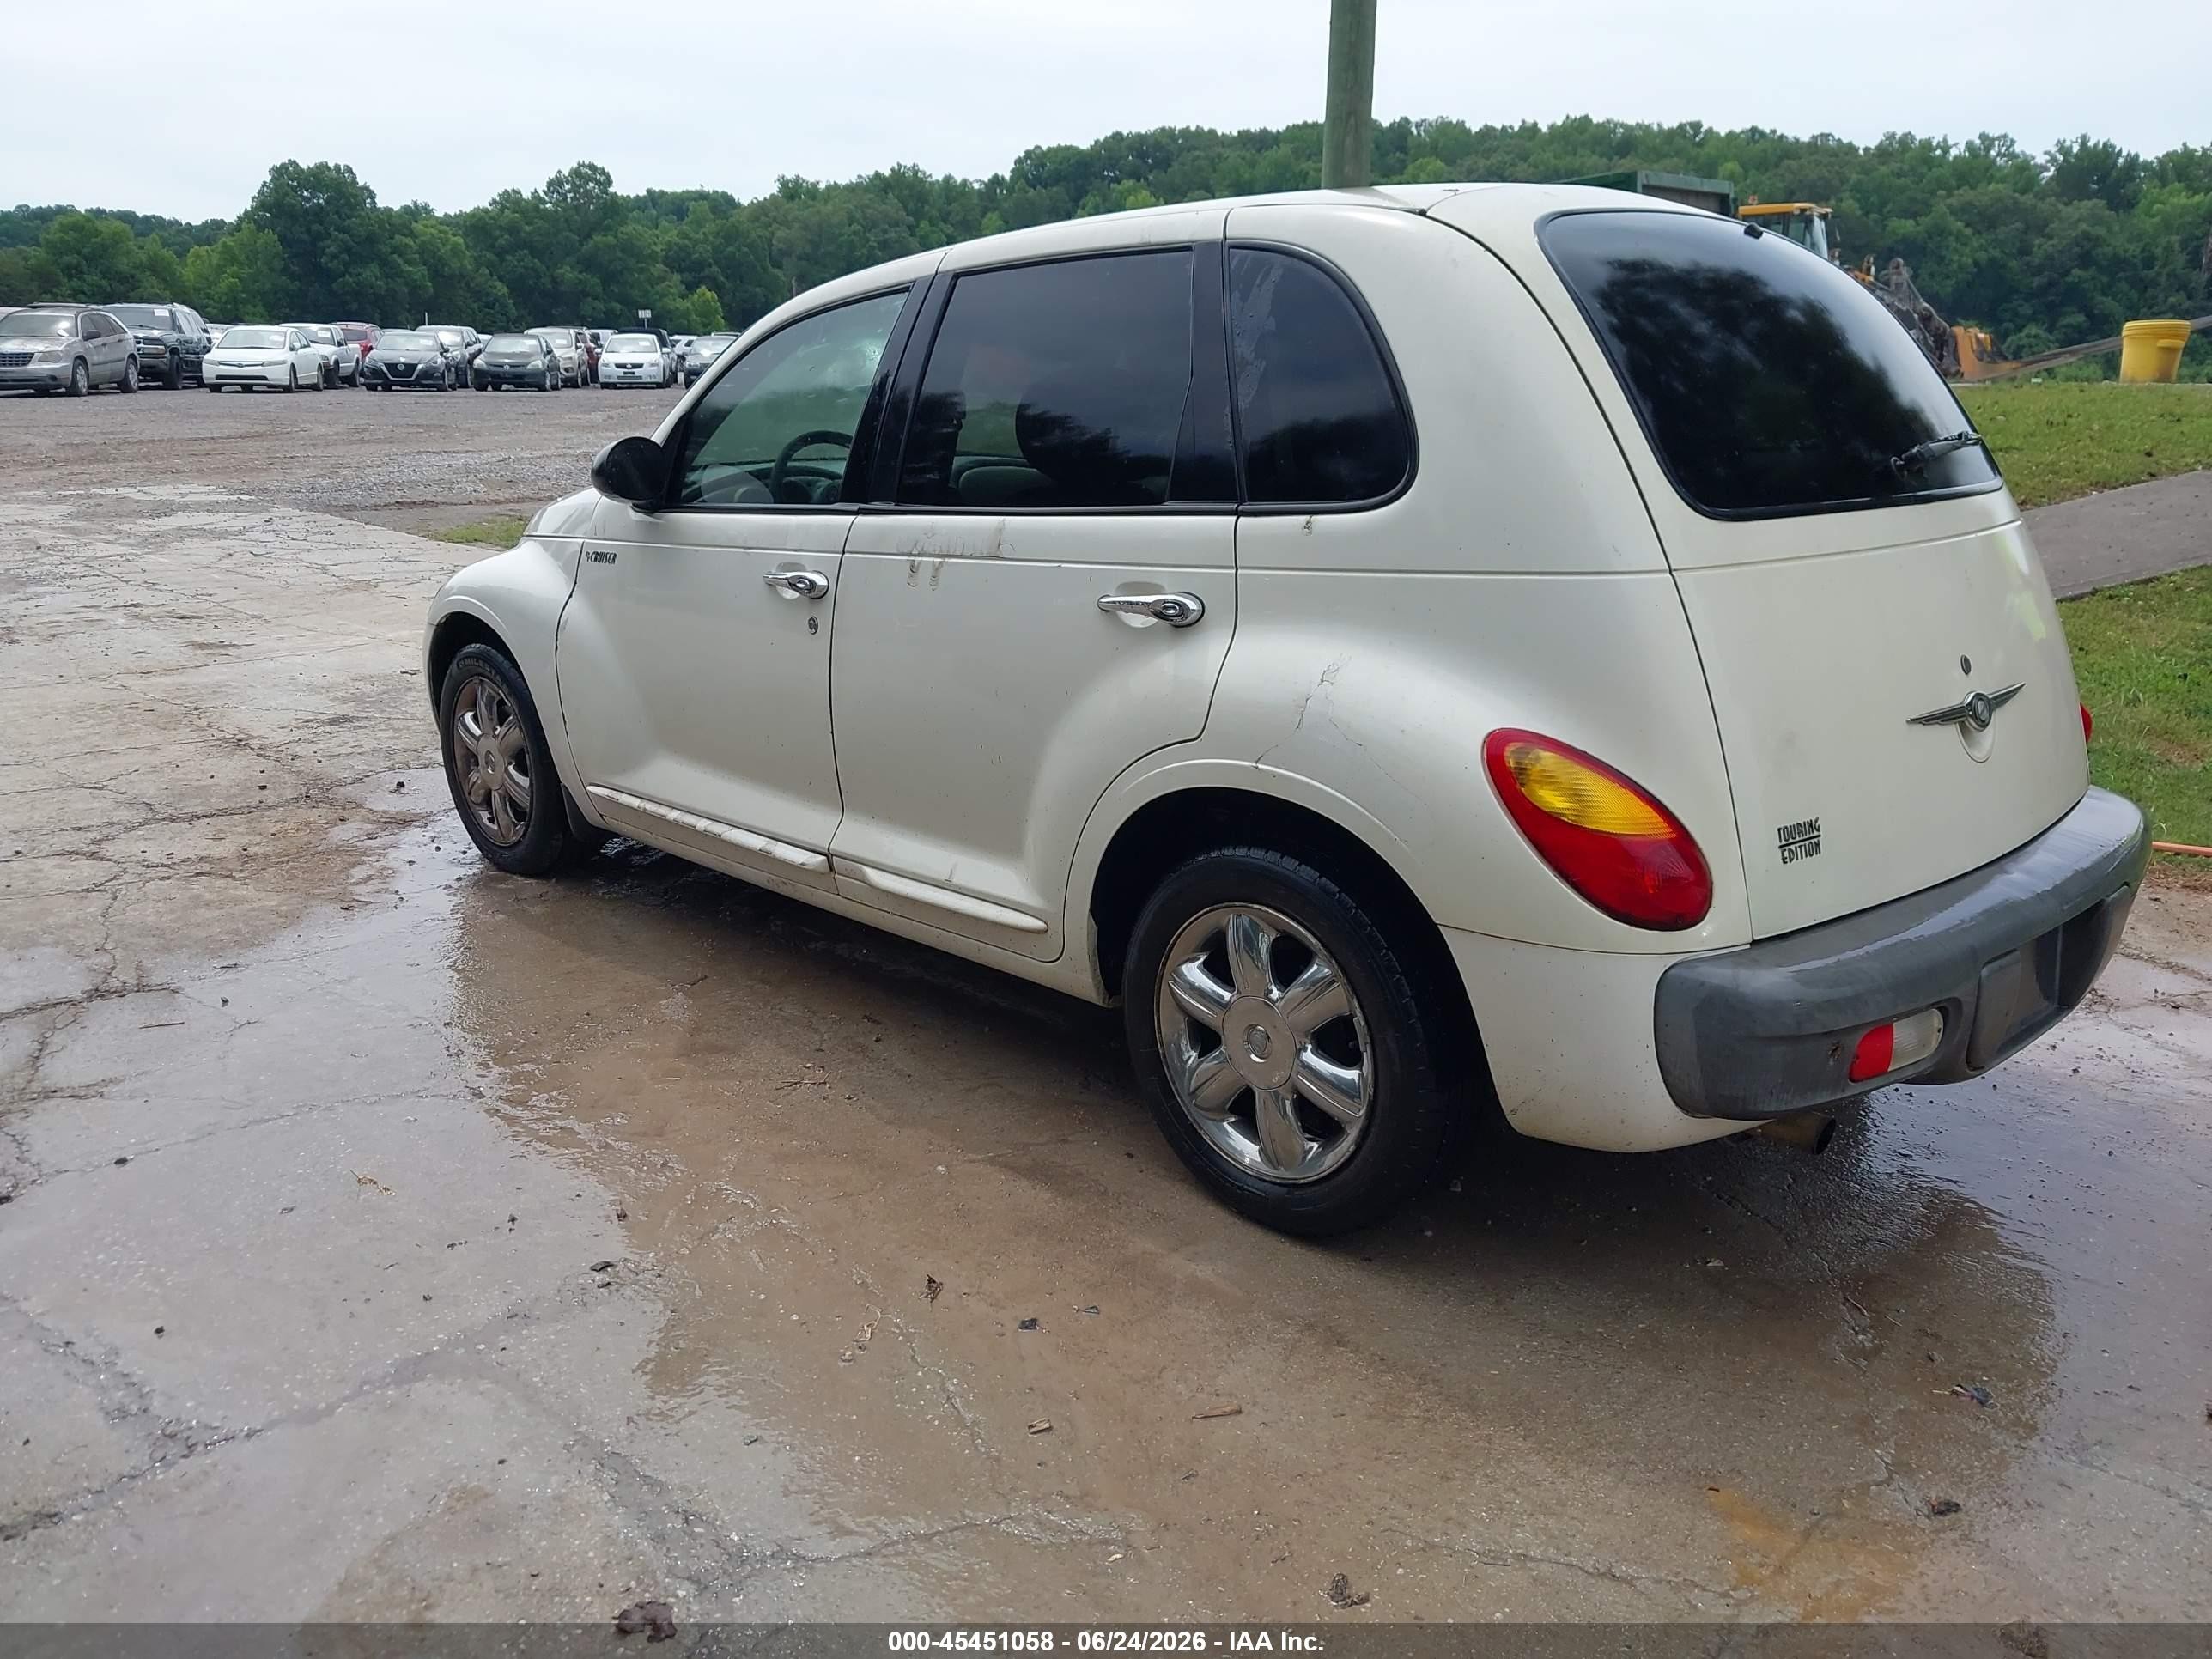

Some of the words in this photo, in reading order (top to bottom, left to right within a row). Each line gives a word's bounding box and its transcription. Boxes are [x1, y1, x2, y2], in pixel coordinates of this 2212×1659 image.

[590, 550, 617, 564] CRUISER
[1778, 817, 1821, 843] TOURING
[1781, 839, 1821, 864] EDITION
